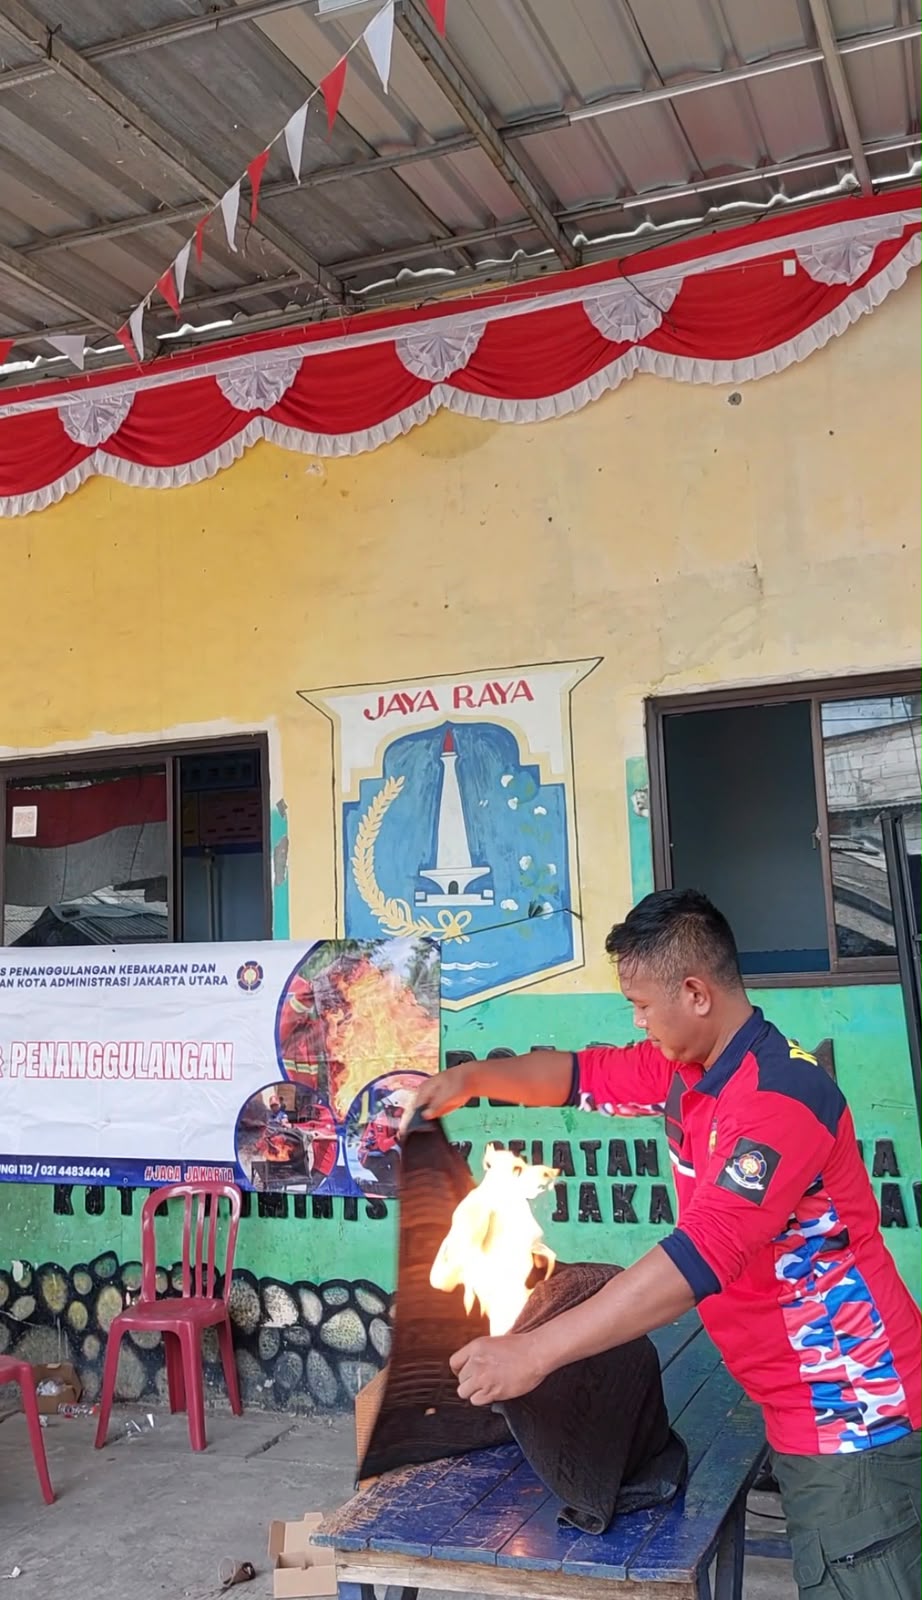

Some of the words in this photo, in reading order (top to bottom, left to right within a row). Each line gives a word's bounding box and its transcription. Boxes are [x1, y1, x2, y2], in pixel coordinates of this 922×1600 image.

[363, 690, 440, 721] JAYA
[453, 680, 535, 709] RAYA
[9, 965, 116, 976] PENANGGULANGAN
[119, 964, 188, 975] KEBAKARAN
[191, 963, 216, 974] DAN
[17, 978, 47, 989] KOTA
[49, 977, 130, 988] ADMINISTRASI
[133, 976, 186, 987] JAKARTA
[189, 975, 229, 986] UTARA
[10, 1041, 234, 1080] PENANGGULANGAN
[0, 1164, 17, 1175] NGI
[19, 1164, 33, 1175] 112
[41, 1165, 57, 1176] 021
[58, 1166, 111, 1178] 44834444
[144, 1165, 181, 1182] #JAGA
[184, 1166, 235, 1183] JAKARTA
